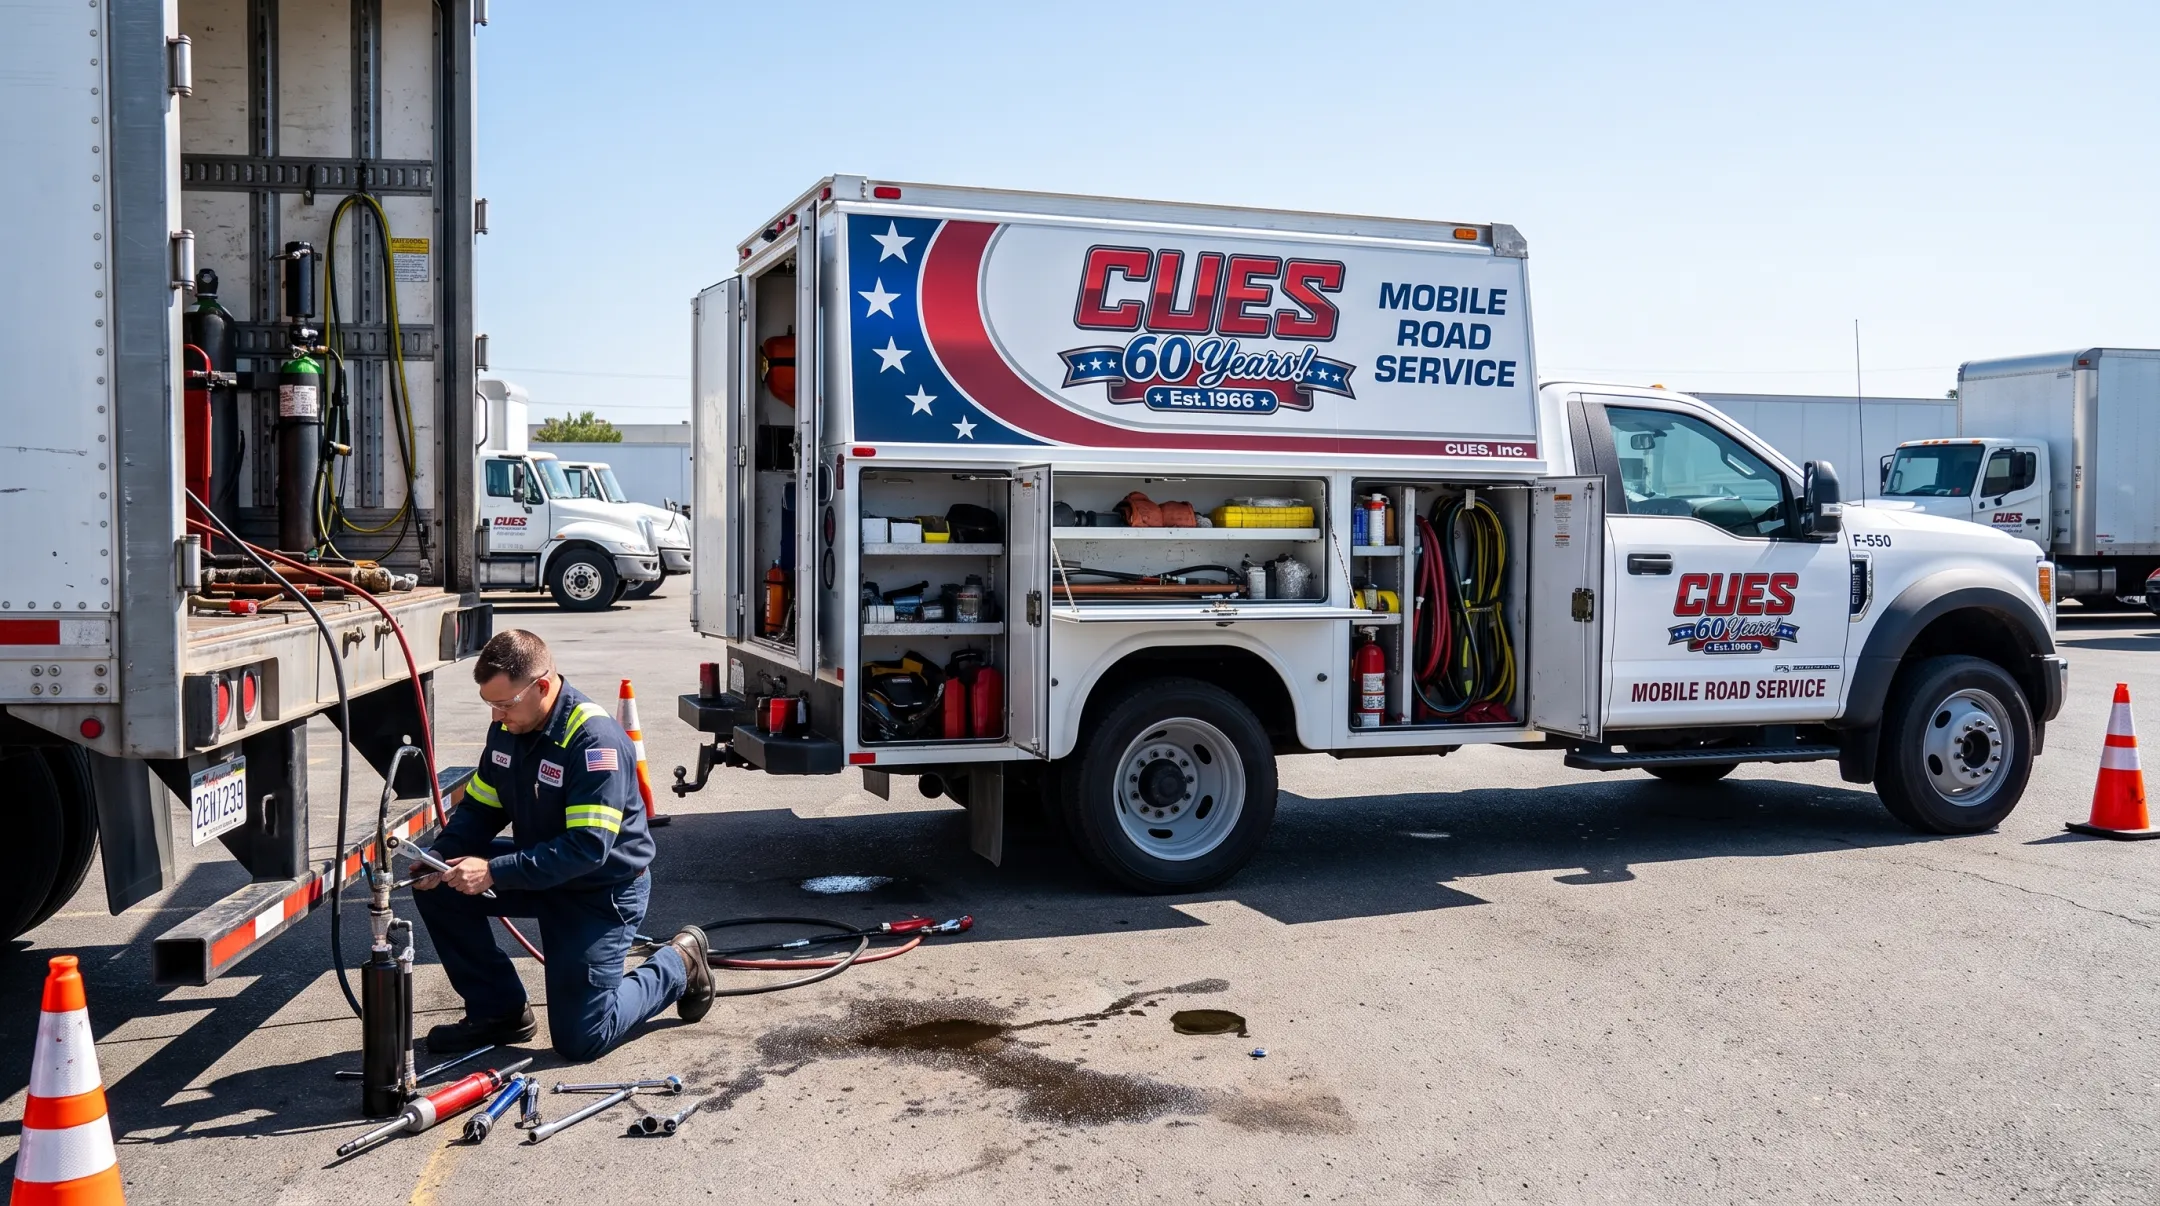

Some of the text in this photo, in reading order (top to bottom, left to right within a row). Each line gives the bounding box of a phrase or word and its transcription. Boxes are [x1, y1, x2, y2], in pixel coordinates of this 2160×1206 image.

[1074, 244, 1346, 342] CUES
[1379, 282, 1508, 315] MOBILE
[1397, 319, 1491, 350] ROAD
[1122, 333, 1318, 390] 60 Years!
[1375, 355, 1516, 387] SERVICE
[1445, 443, 1528, 457] CUES, Inc.
[493, 516, 528, 527] CUES
[1992, 512, 2023, 523] CUES
[1853, 534, 1892, 547] F-550
[1673, 572, 1799, 617] CUES
[1695, 616, 1727, 640] 60
[1631, 679, 1826, 702] MOBILE ROAD SERVICE
